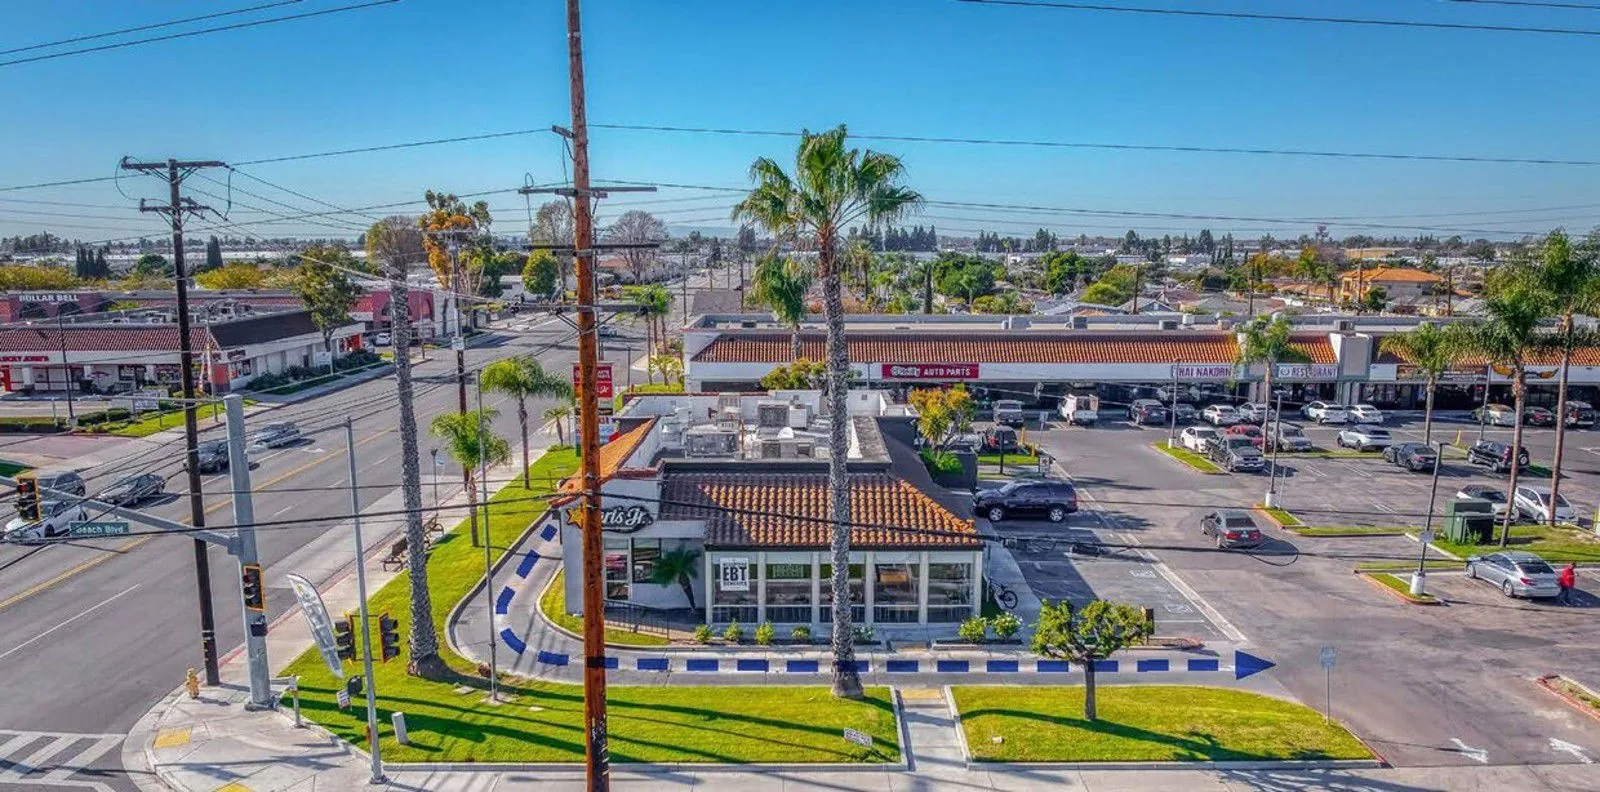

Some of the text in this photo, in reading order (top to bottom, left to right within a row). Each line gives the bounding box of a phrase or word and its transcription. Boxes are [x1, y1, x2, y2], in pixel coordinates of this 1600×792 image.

[923, 368, 944, 376] AUTO
[946, 368, 971, 376] PARTS
[1196, 367, 1231, 376] NAKORN
[75, 525, 124, 534] Beach Blvd
[723, 566, 747, 581] EBT
